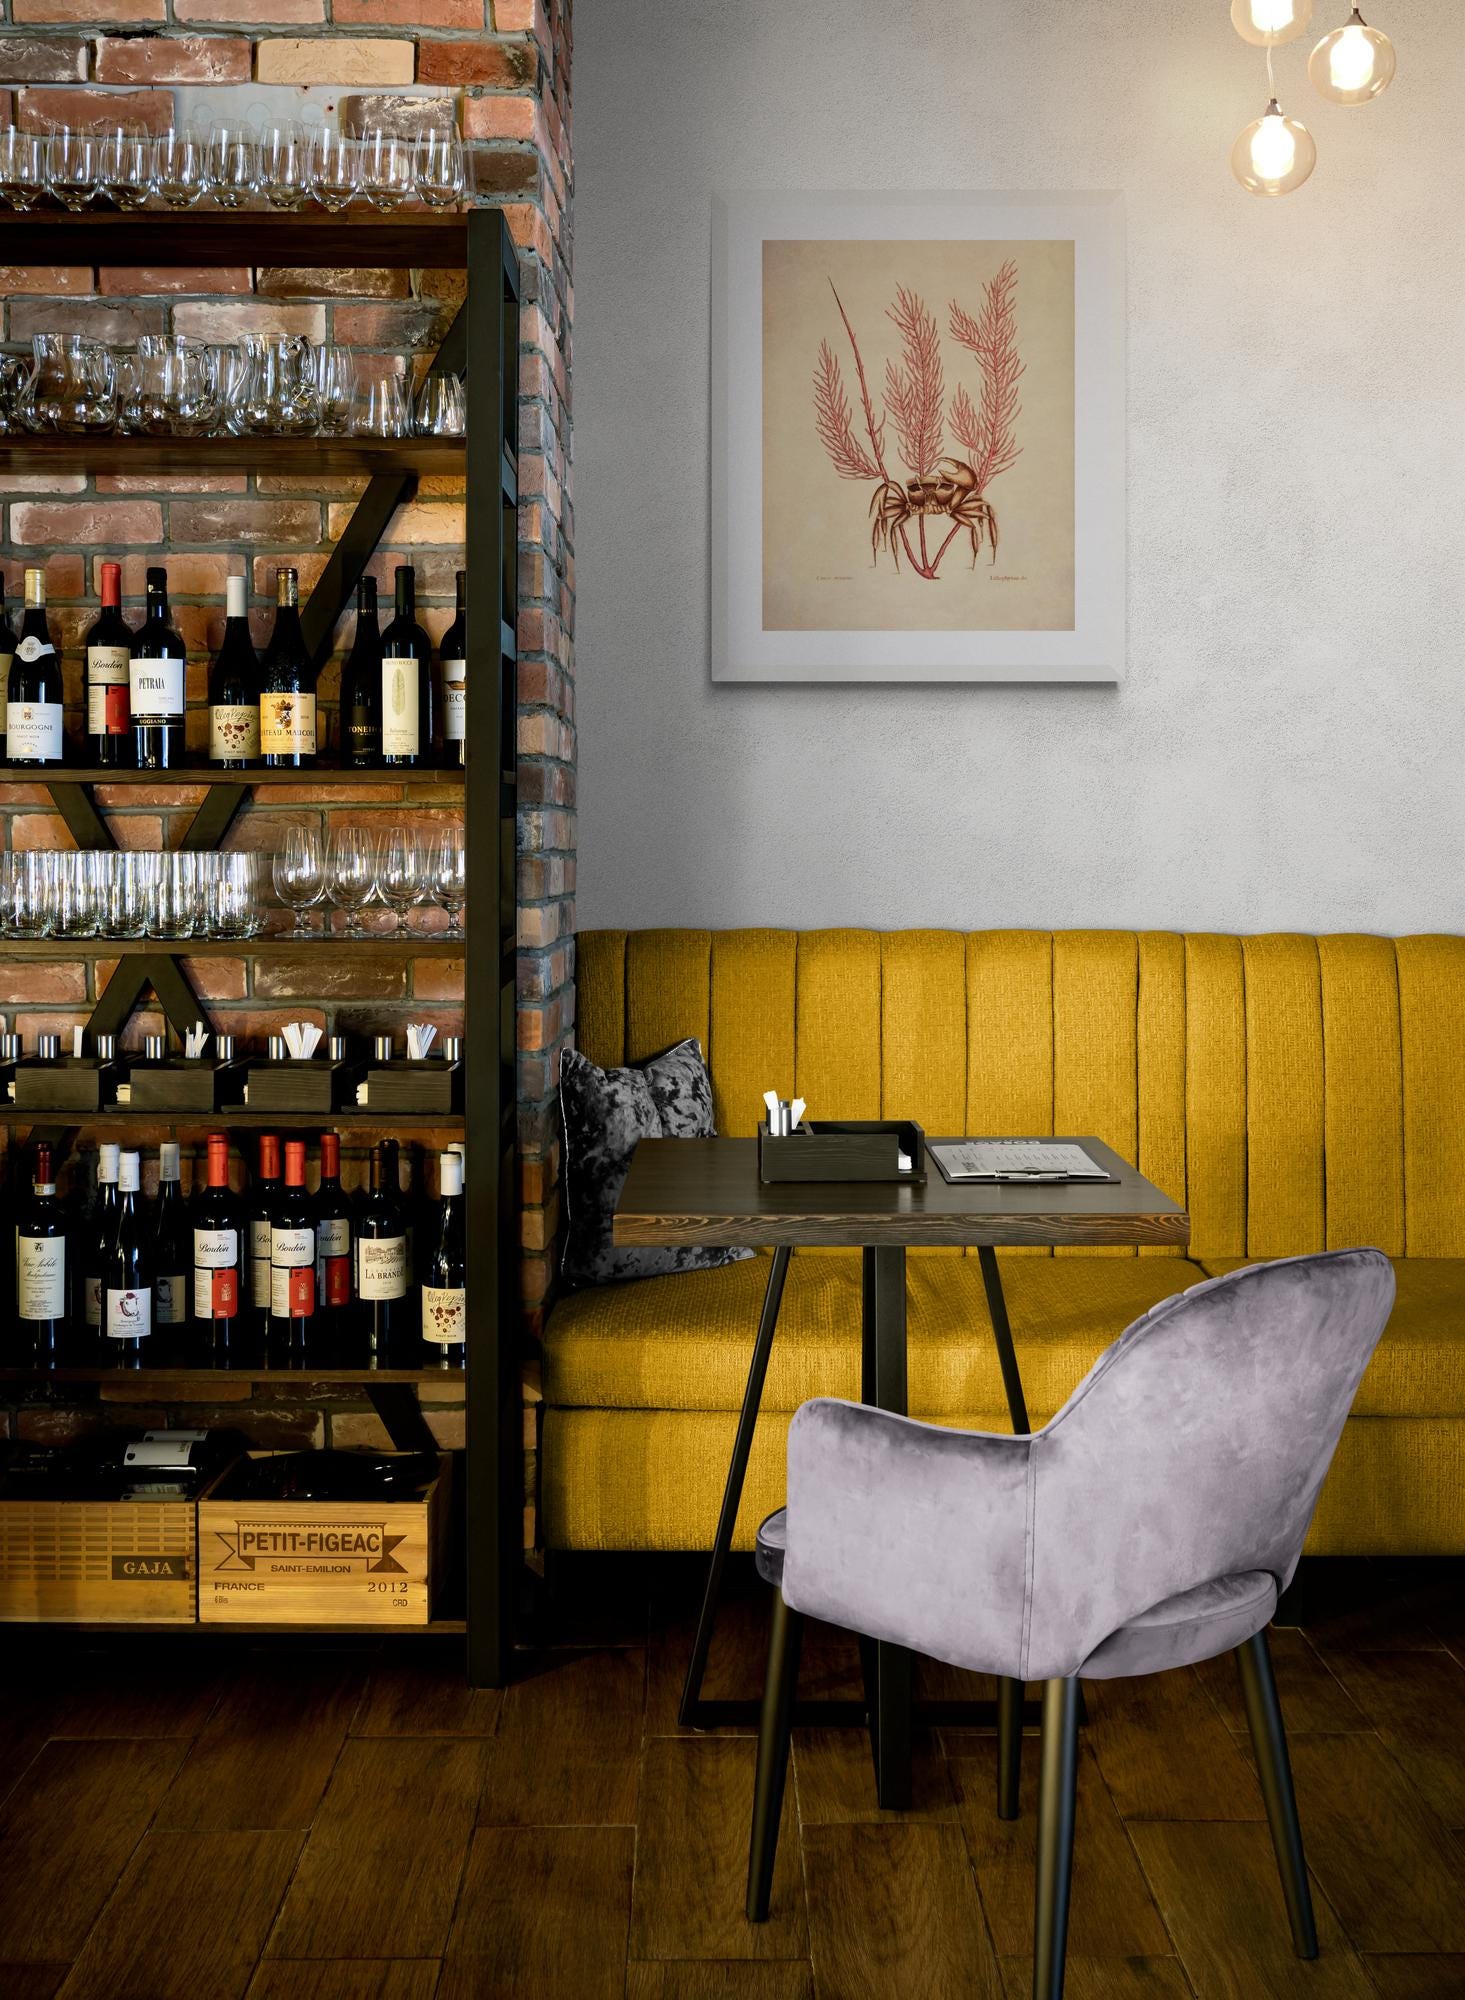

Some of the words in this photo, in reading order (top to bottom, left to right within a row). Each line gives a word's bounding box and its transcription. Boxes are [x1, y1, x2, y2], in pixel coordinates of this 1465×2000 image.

[91, 659, 123, 670] Bordón
[138, 677, 165, 690] PETRAIA
[8, 723, 54, 731] BOURGOGNE
[199, 1241, 229, 1253] Bordón
[275, 1241, 306, 1253] Bordón
[242, 1531, 381, 1553] PETIT-FIGEAC
[123, 1561, 174, 1575] GAJA
[270, 1564, 352, 1573] SAINT-EMILION
[214, 1582, 265, 1591] FRANCE
[367, 1582, 409, 1593] 2012
[392, 1598, 408, 1607] CRD
